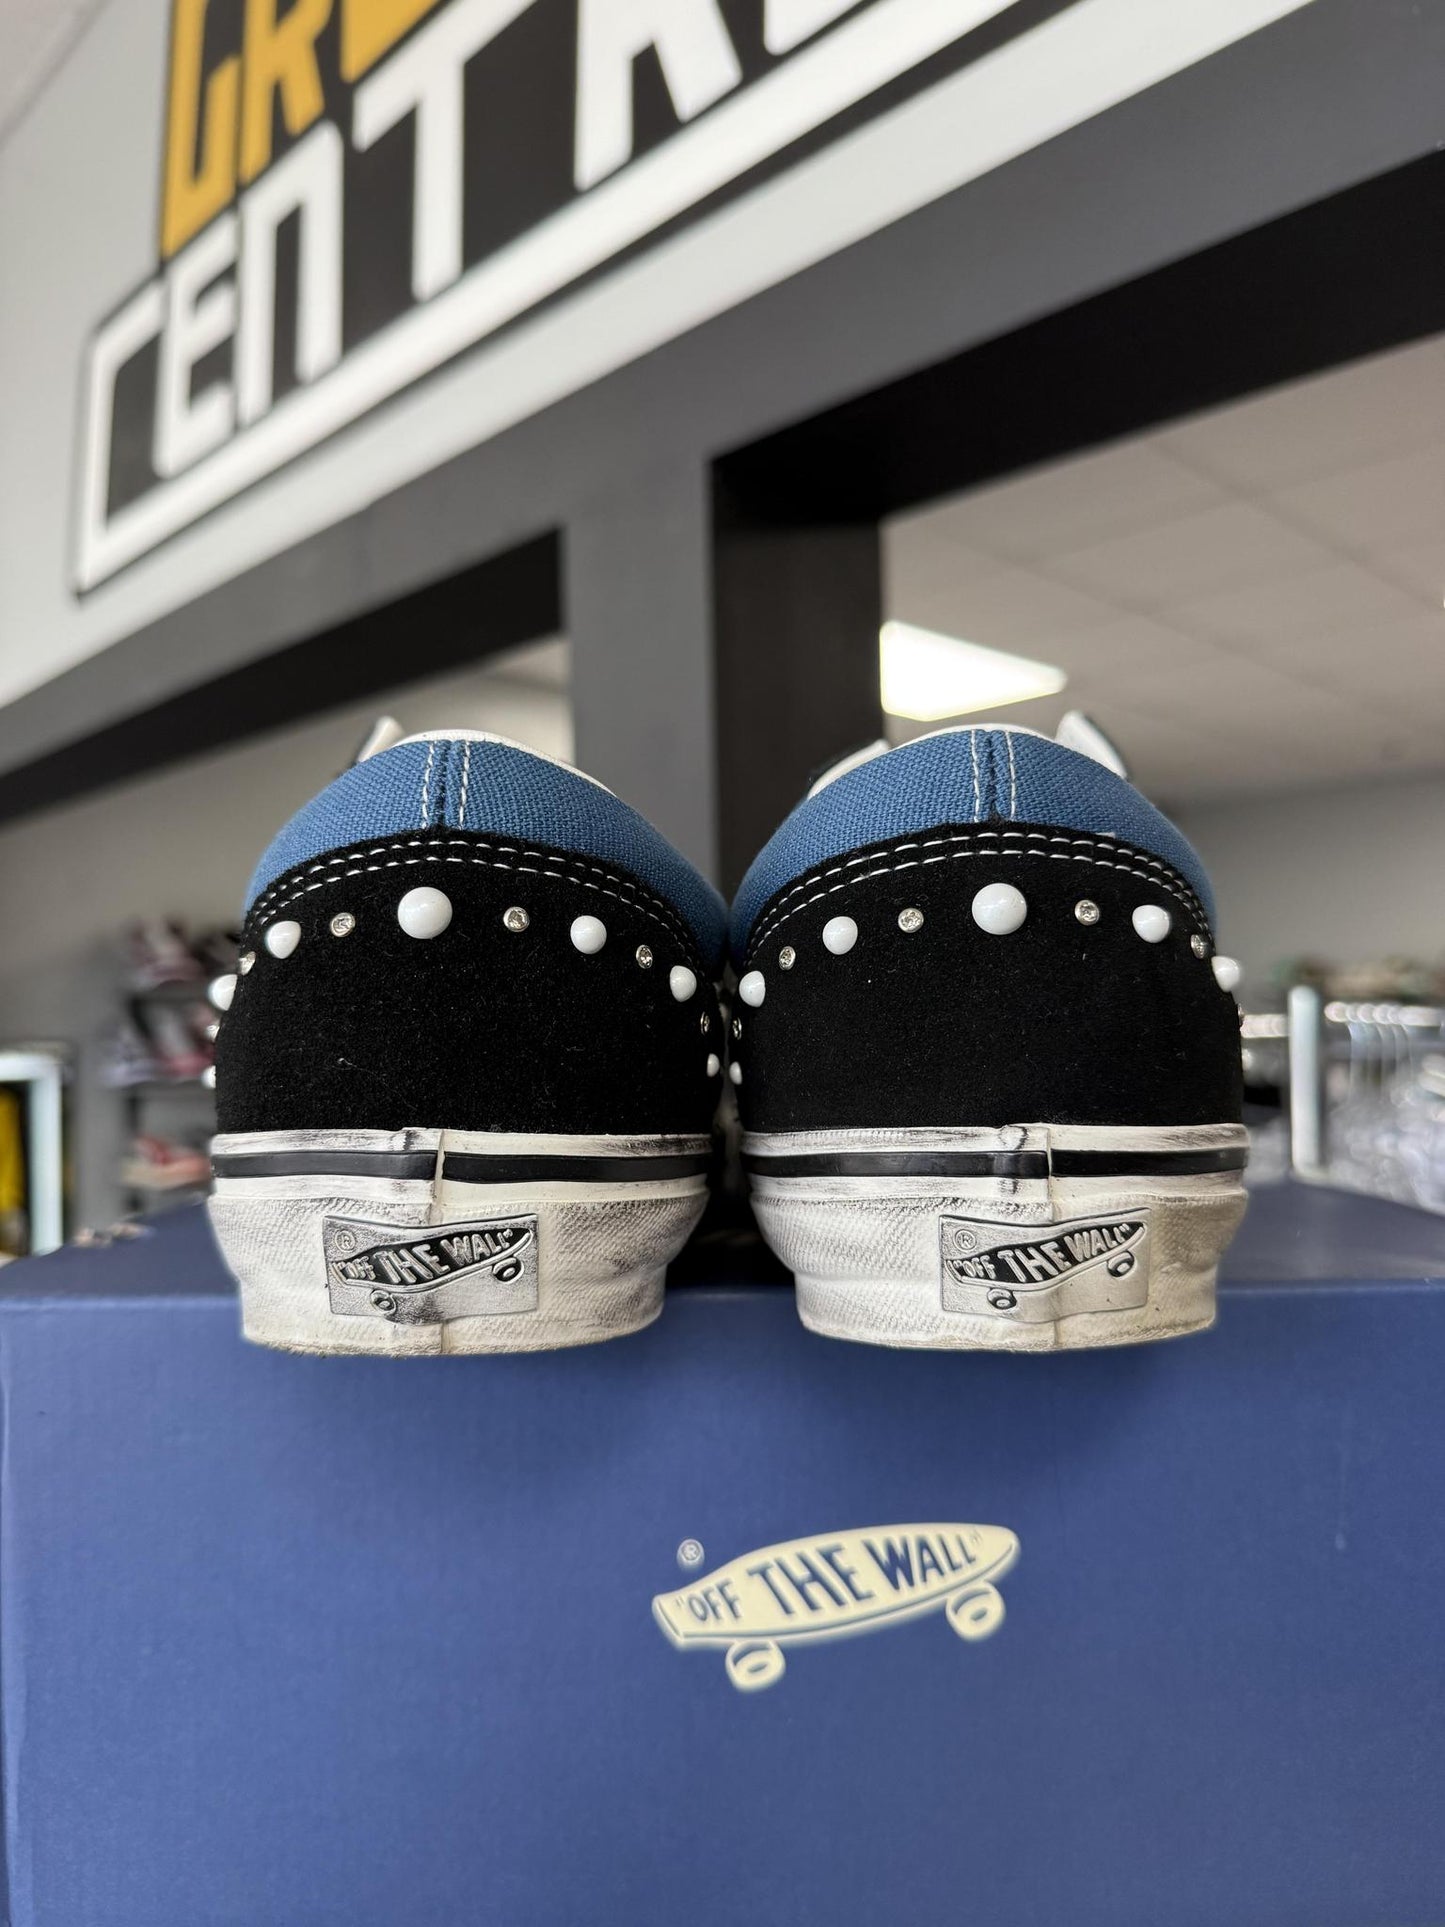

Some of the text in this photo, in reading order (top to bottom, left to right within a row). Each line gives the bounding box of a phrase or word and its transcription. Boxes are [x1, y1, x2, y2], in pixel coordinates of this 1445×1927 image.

[80, 0, 870, 592] CENTR
[373, 1244, 451, 1284] THE
[997, 1242, 1073, 1283] THE
[747, 1542, 877, 1616] THE
